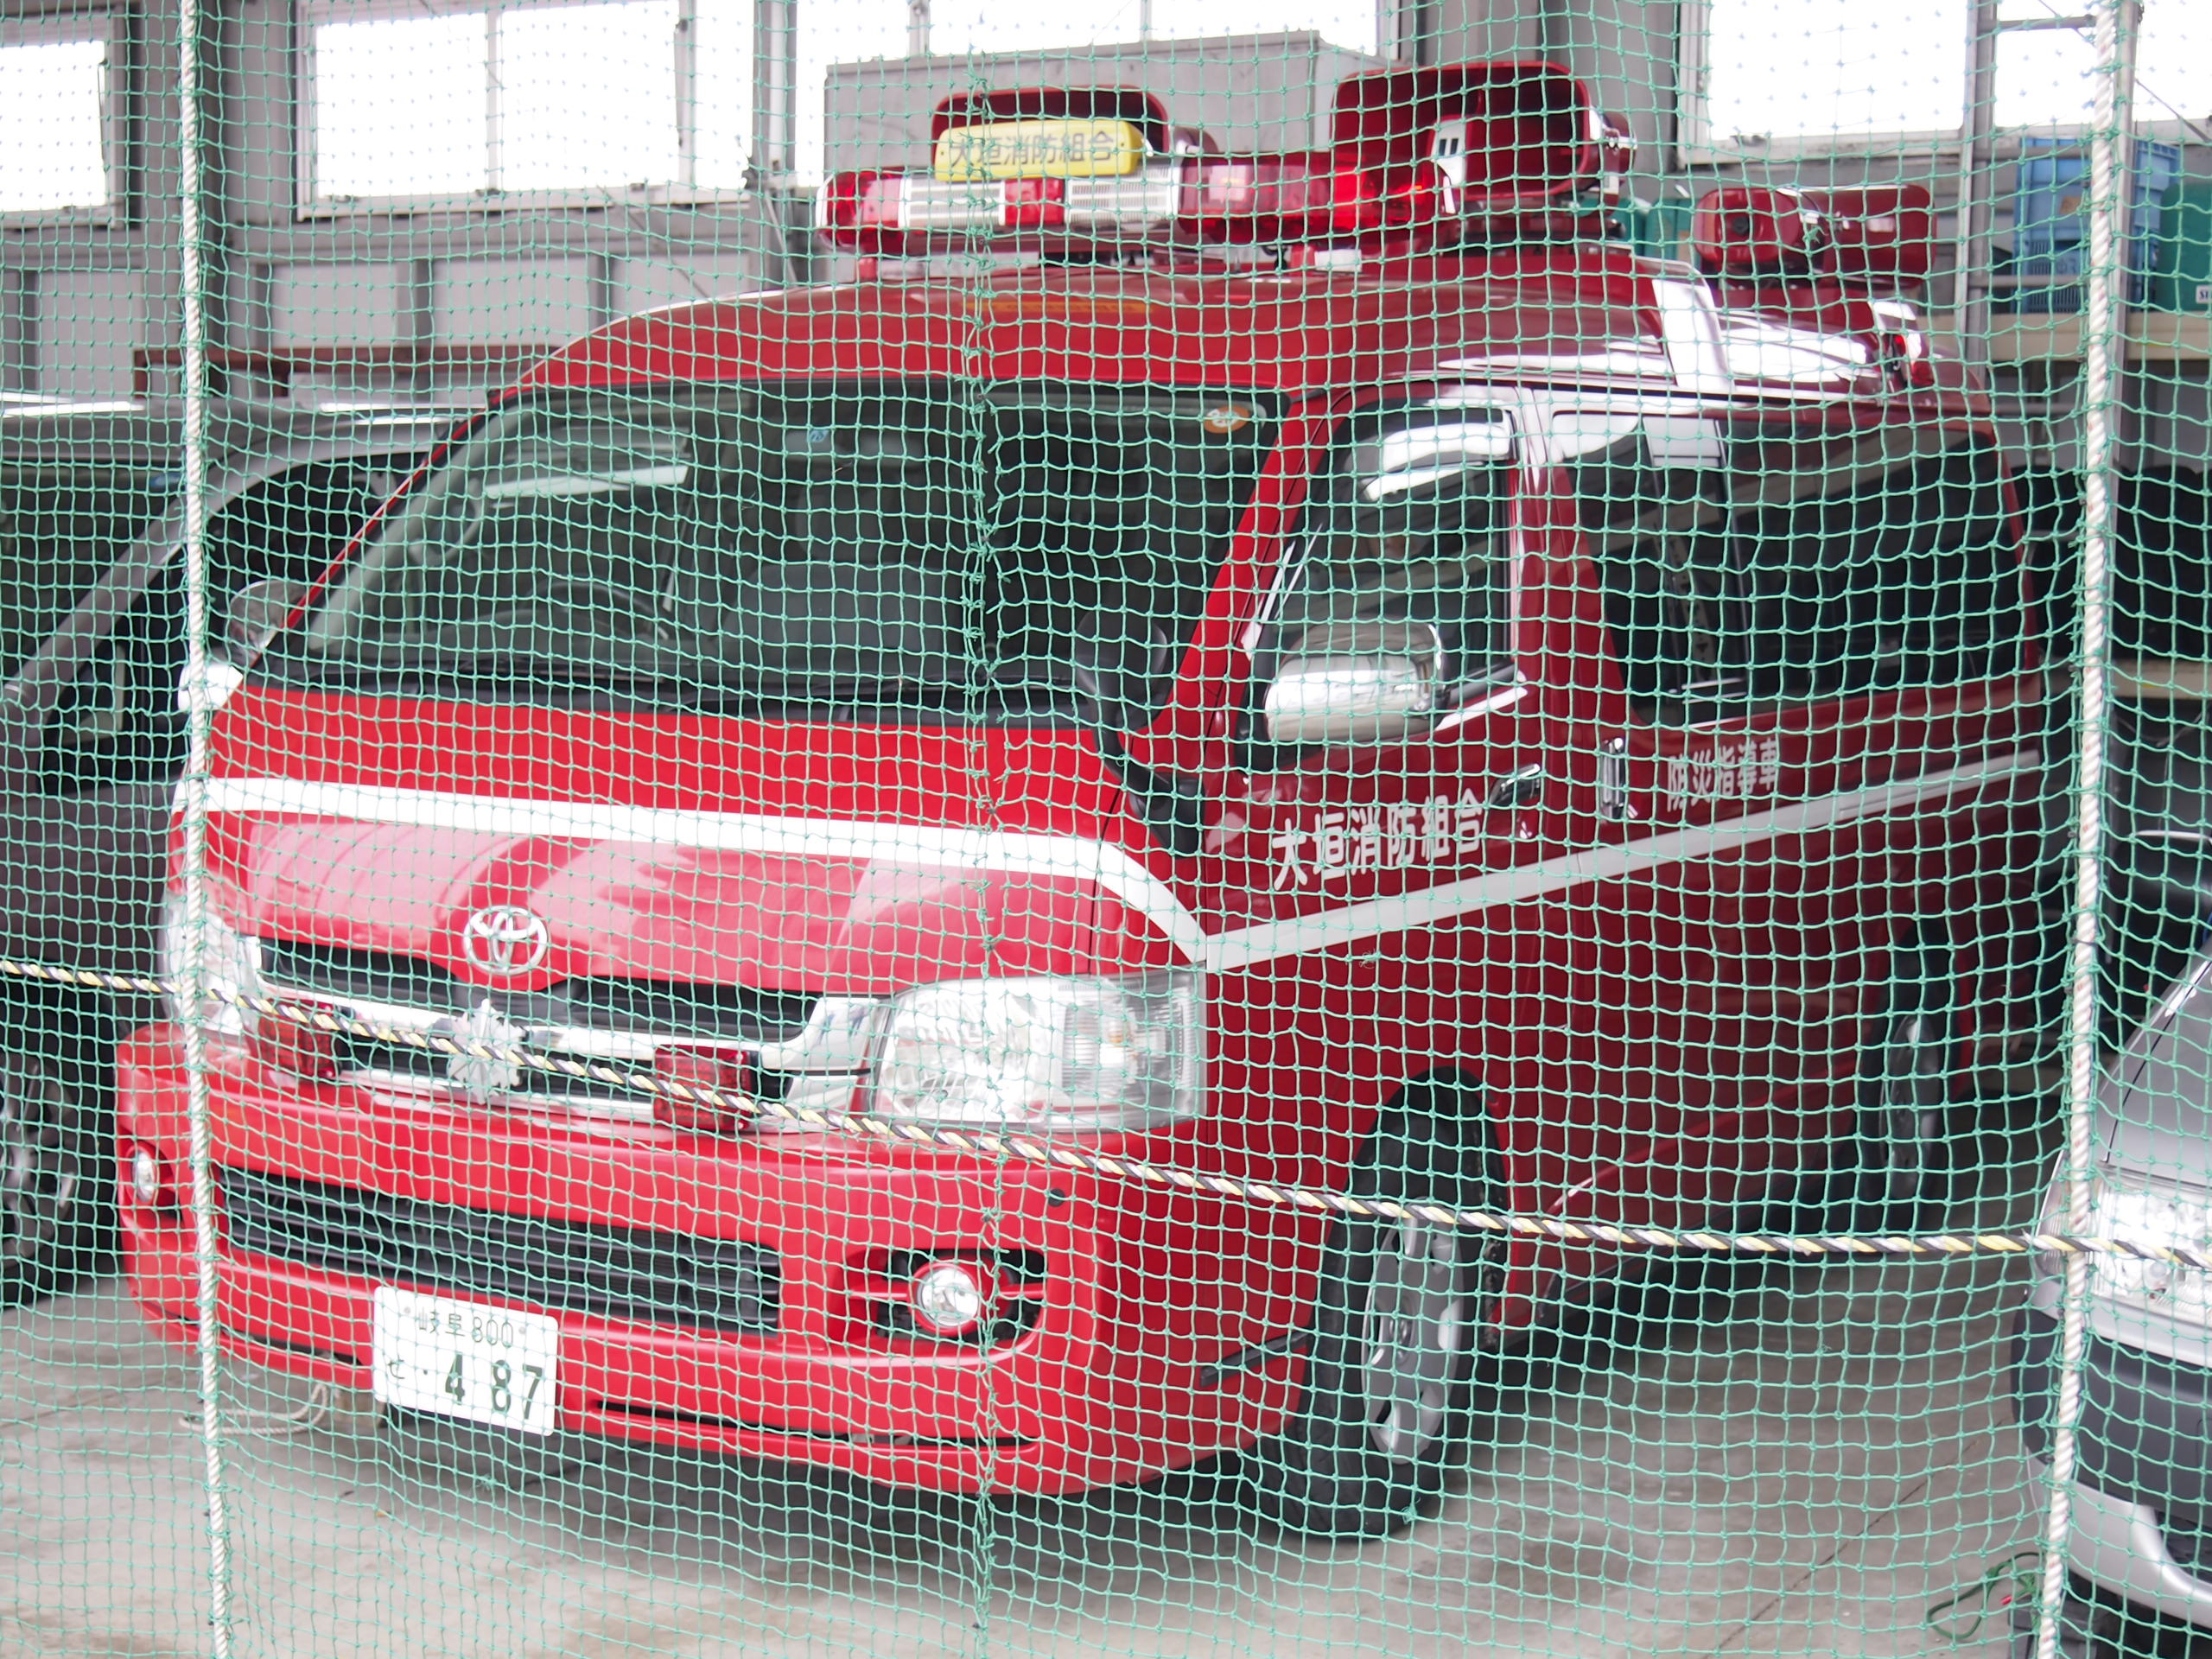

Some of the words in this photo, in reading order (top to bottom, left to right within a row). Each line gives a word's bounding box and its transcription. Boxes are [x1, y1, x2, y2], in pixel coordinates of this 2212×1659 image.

[951, 130, 1115, 167] 大垣消防組合
[1272, 788, 1484, 891] 大垣消防組合
